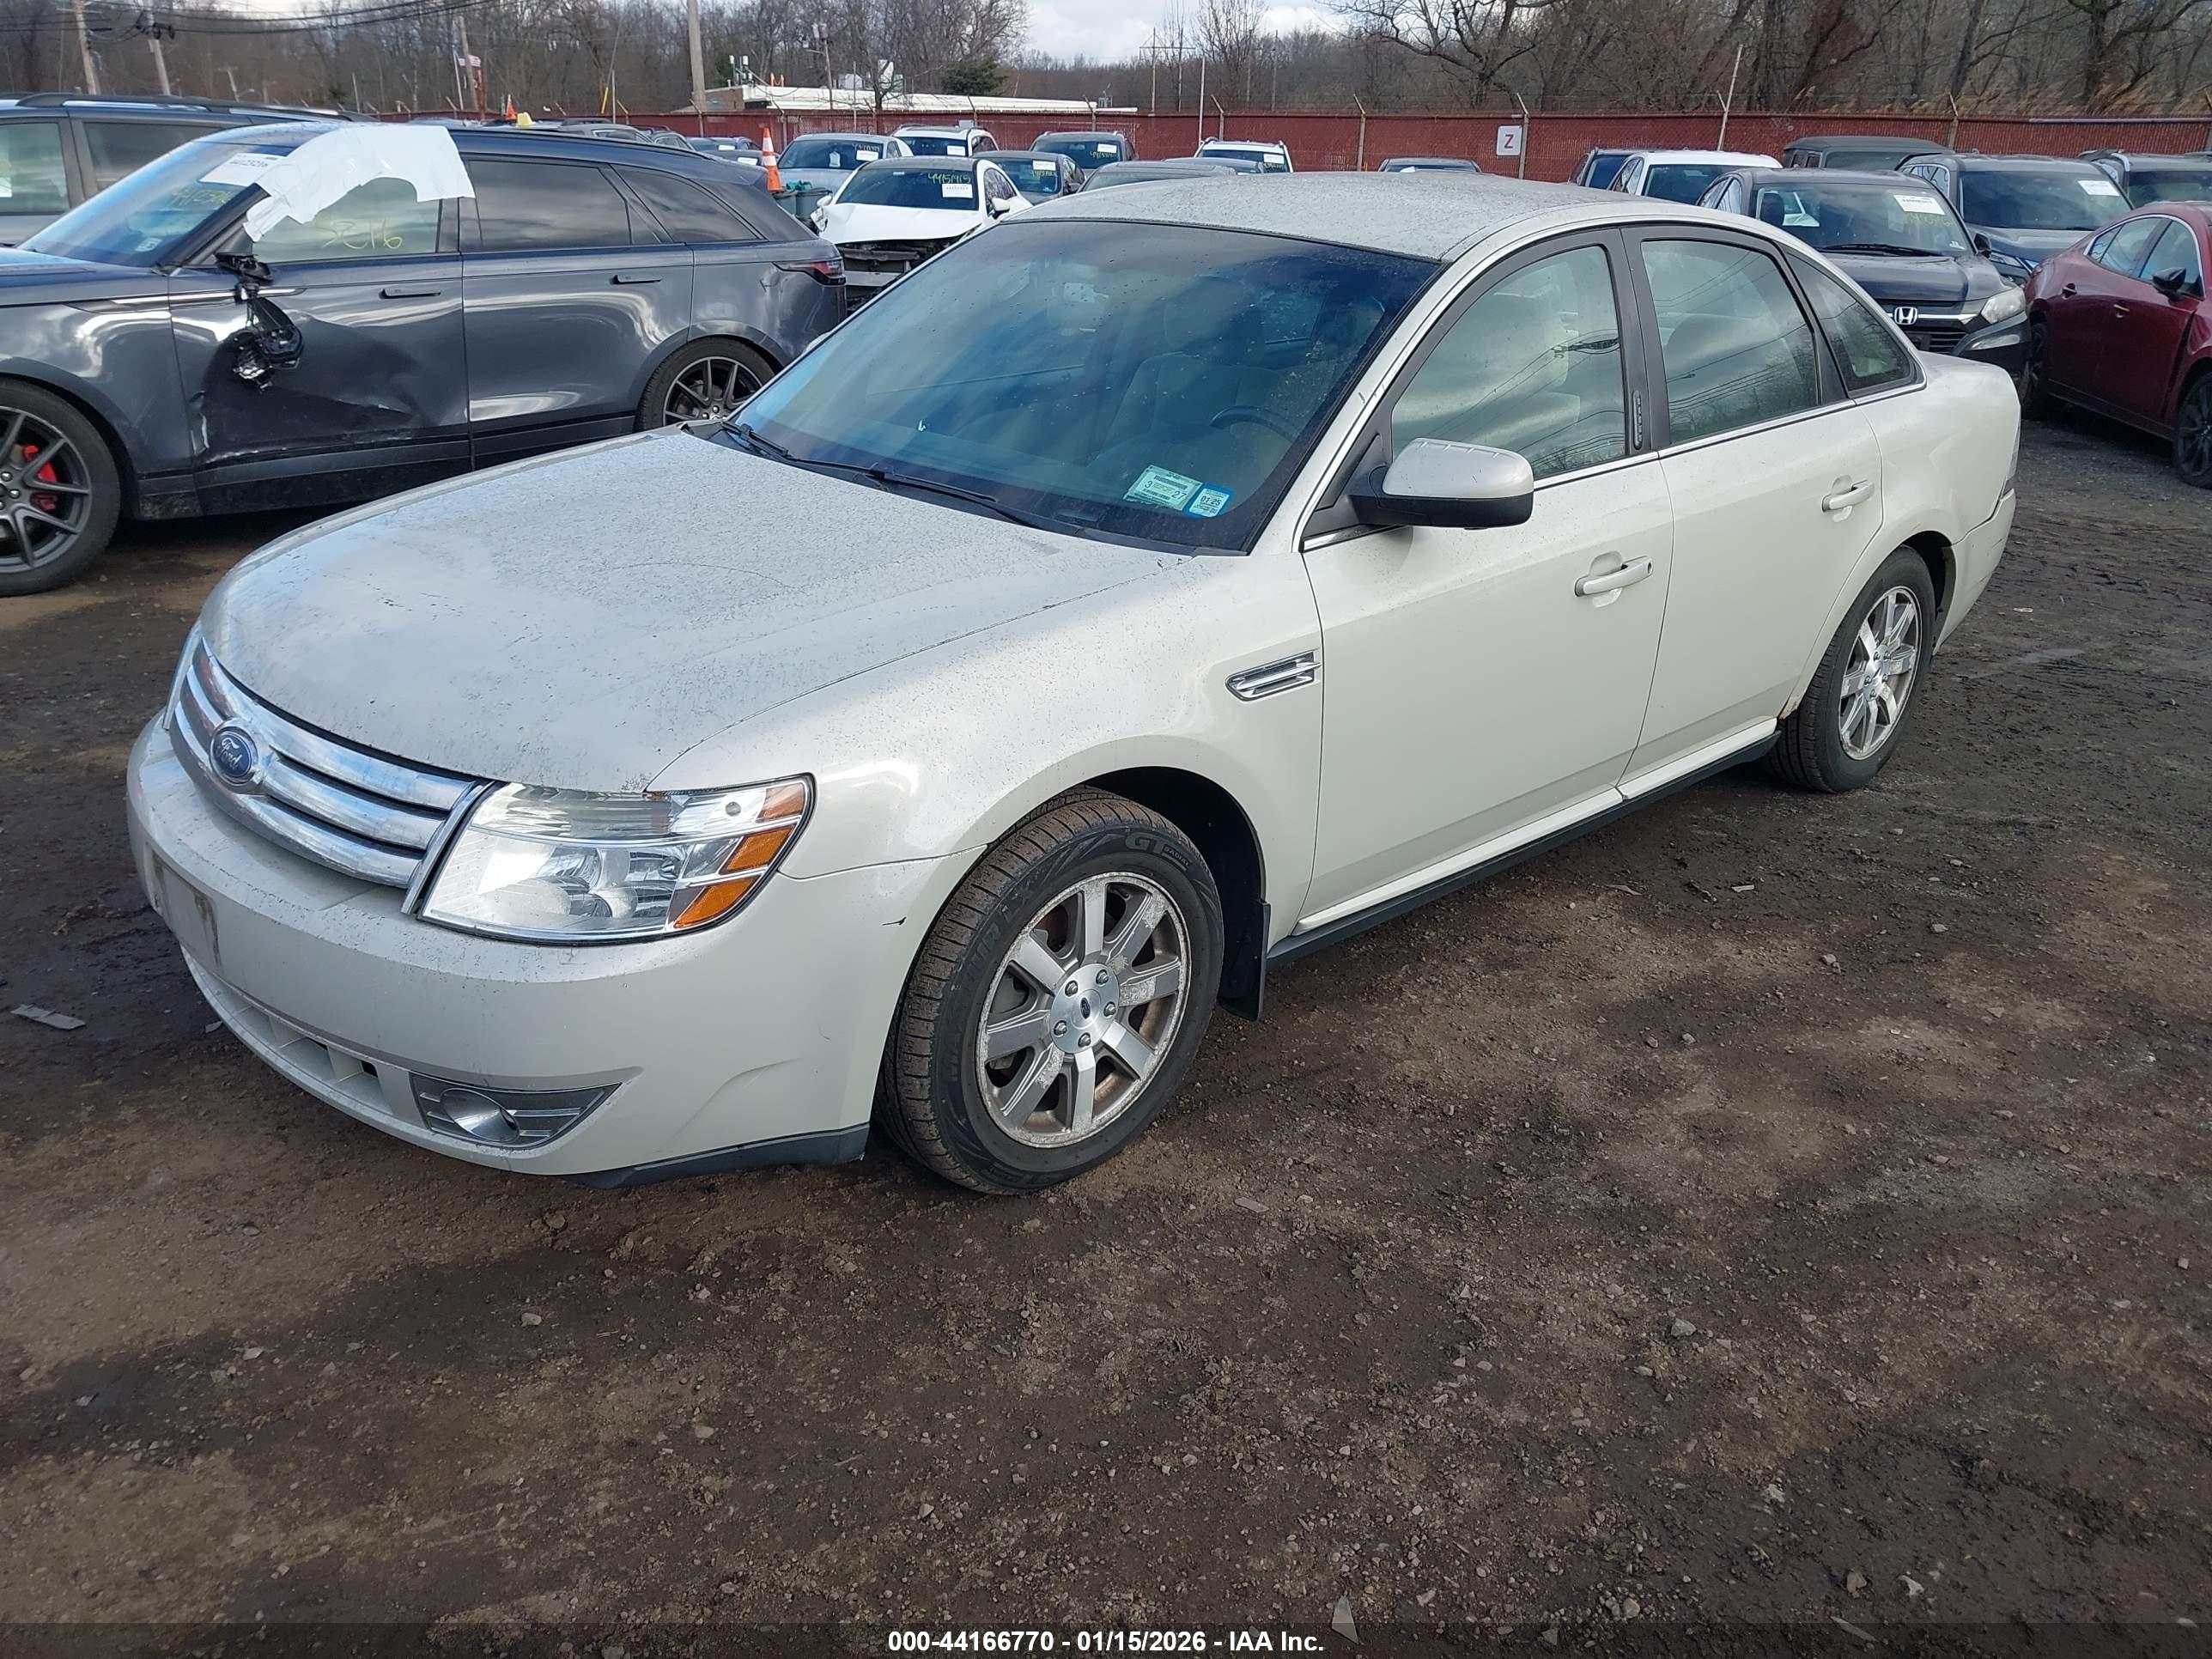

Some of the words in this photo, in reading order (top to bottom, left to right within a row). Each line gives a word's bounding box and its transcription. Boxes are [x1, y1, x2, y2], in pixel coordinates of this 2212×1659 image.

[1504, 134, 1514, 149] Z
[1144, 480, 1153, 489] 3
[1171, 490, 1188, 500] 27
[1125, 832, 1173, 853] GT
